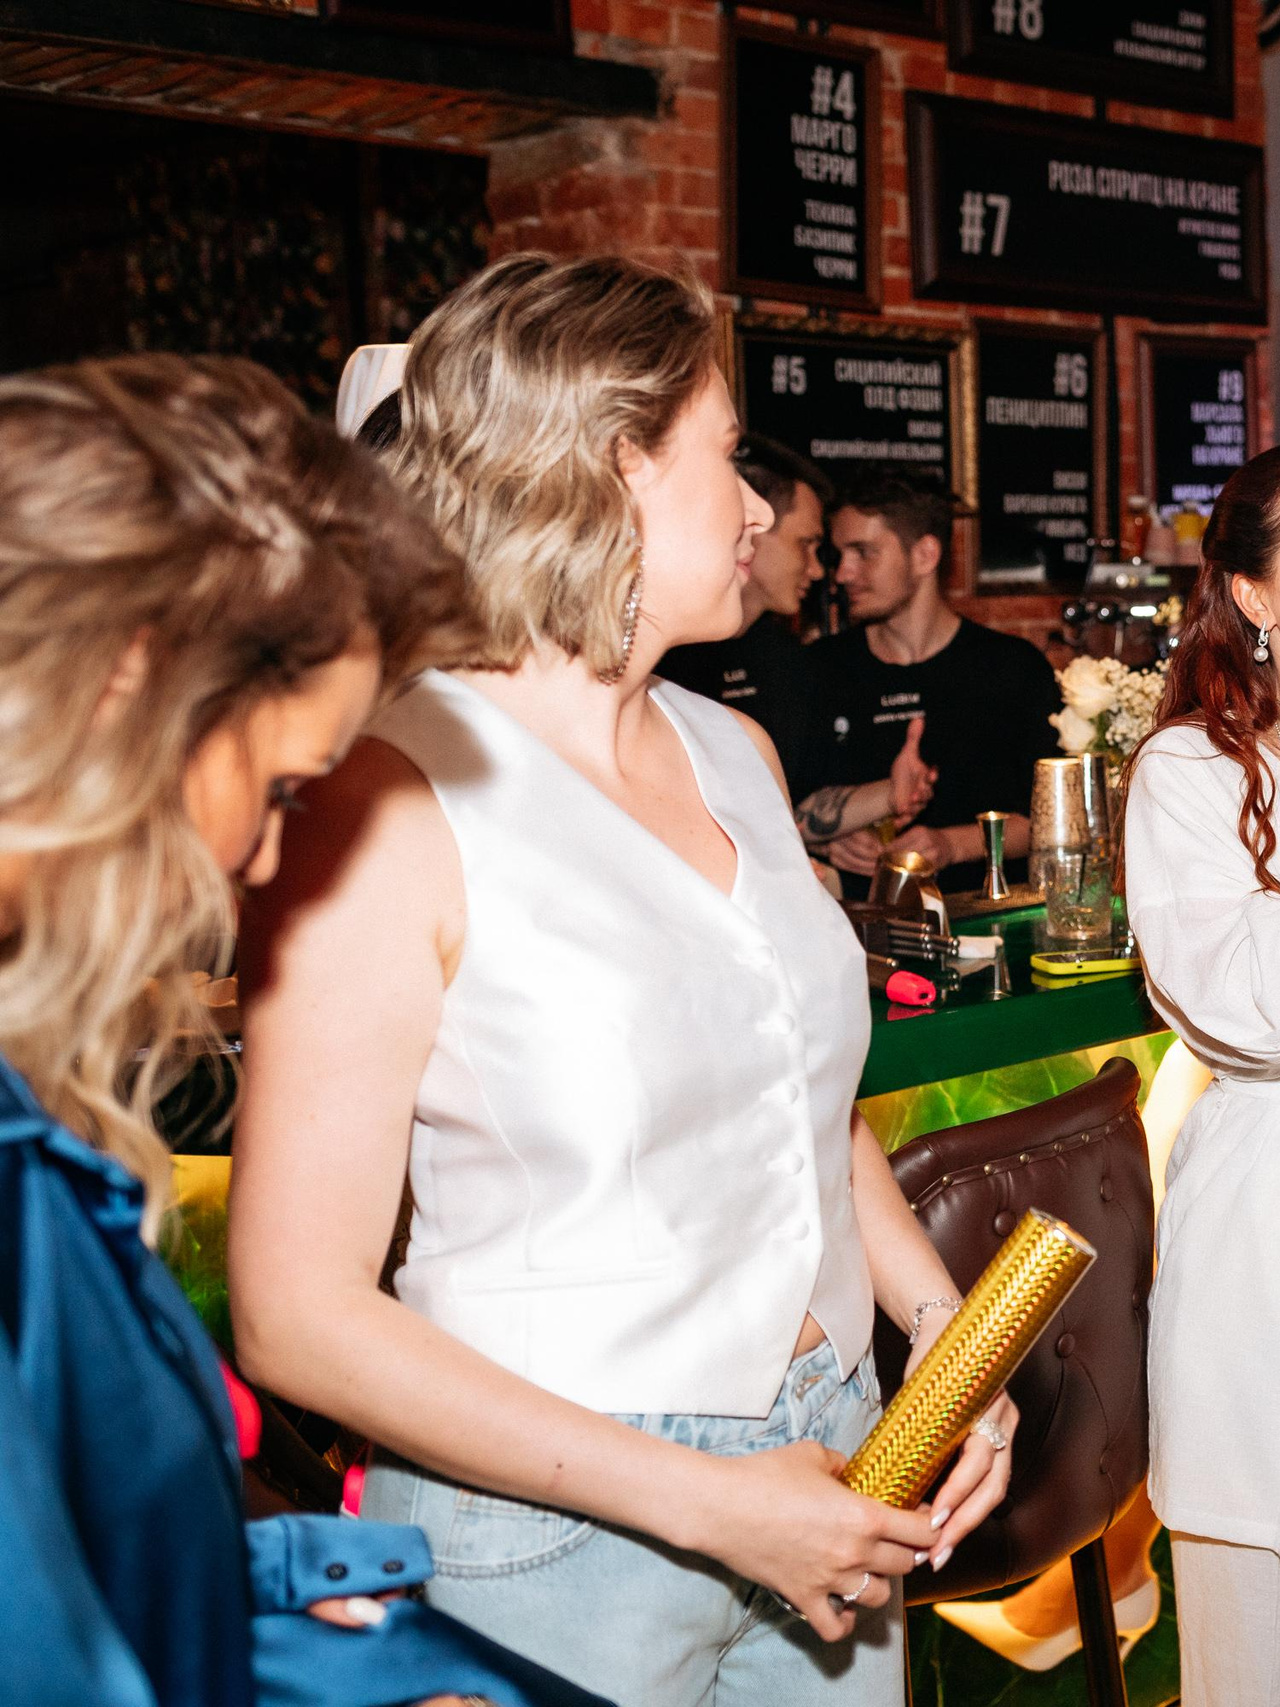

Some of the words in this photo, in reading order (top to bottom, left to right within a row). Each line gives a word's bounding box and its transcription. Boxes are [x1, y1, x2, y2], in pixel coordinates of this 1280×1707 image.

[810, 66, 856, 120] #4
[791, 114, 857, 154] МАРГО
[794, 149, 857, 187] ЧЕРРИ
[959, 192, 1010, 256] #7
[771, 355, 807, 395] #5
[1053, 353, 1088, 396] #6
[1218, 370, 1244, 402] #9
